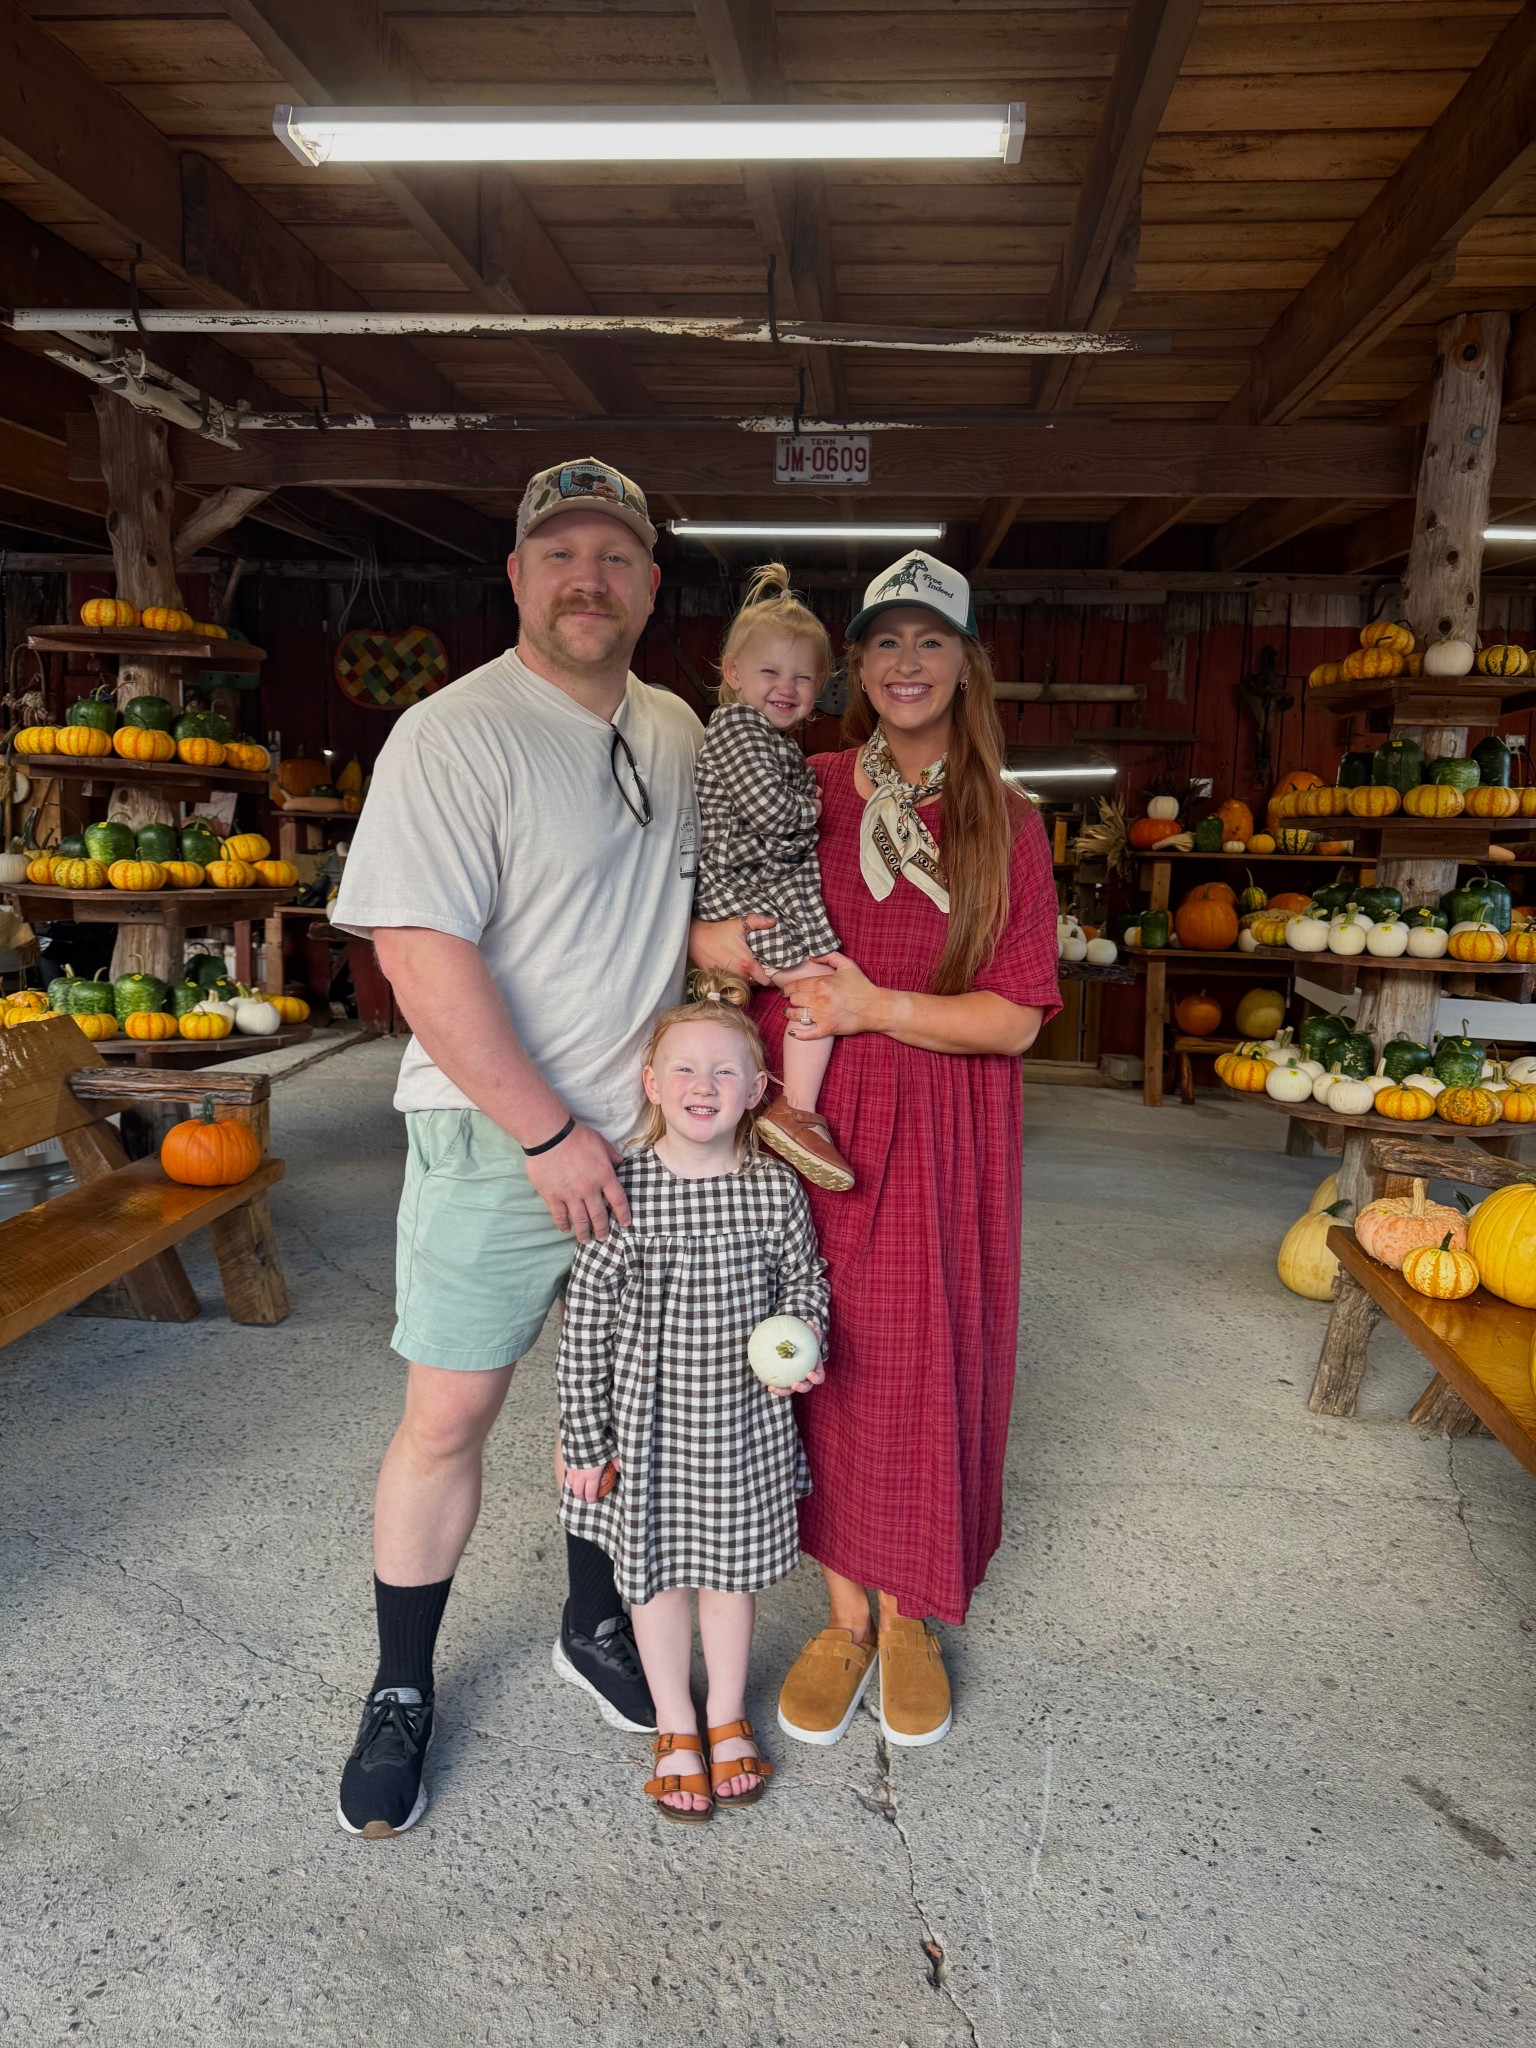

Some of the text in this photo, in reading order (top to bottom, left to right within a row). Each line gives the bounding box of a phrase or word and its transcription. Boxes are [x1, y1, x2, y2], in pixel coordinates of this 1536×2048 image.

[778, 446, 866, 472] JM-0609
[922, 574, 943, 586] Free
[927, 581, 954, 599] Indeed
